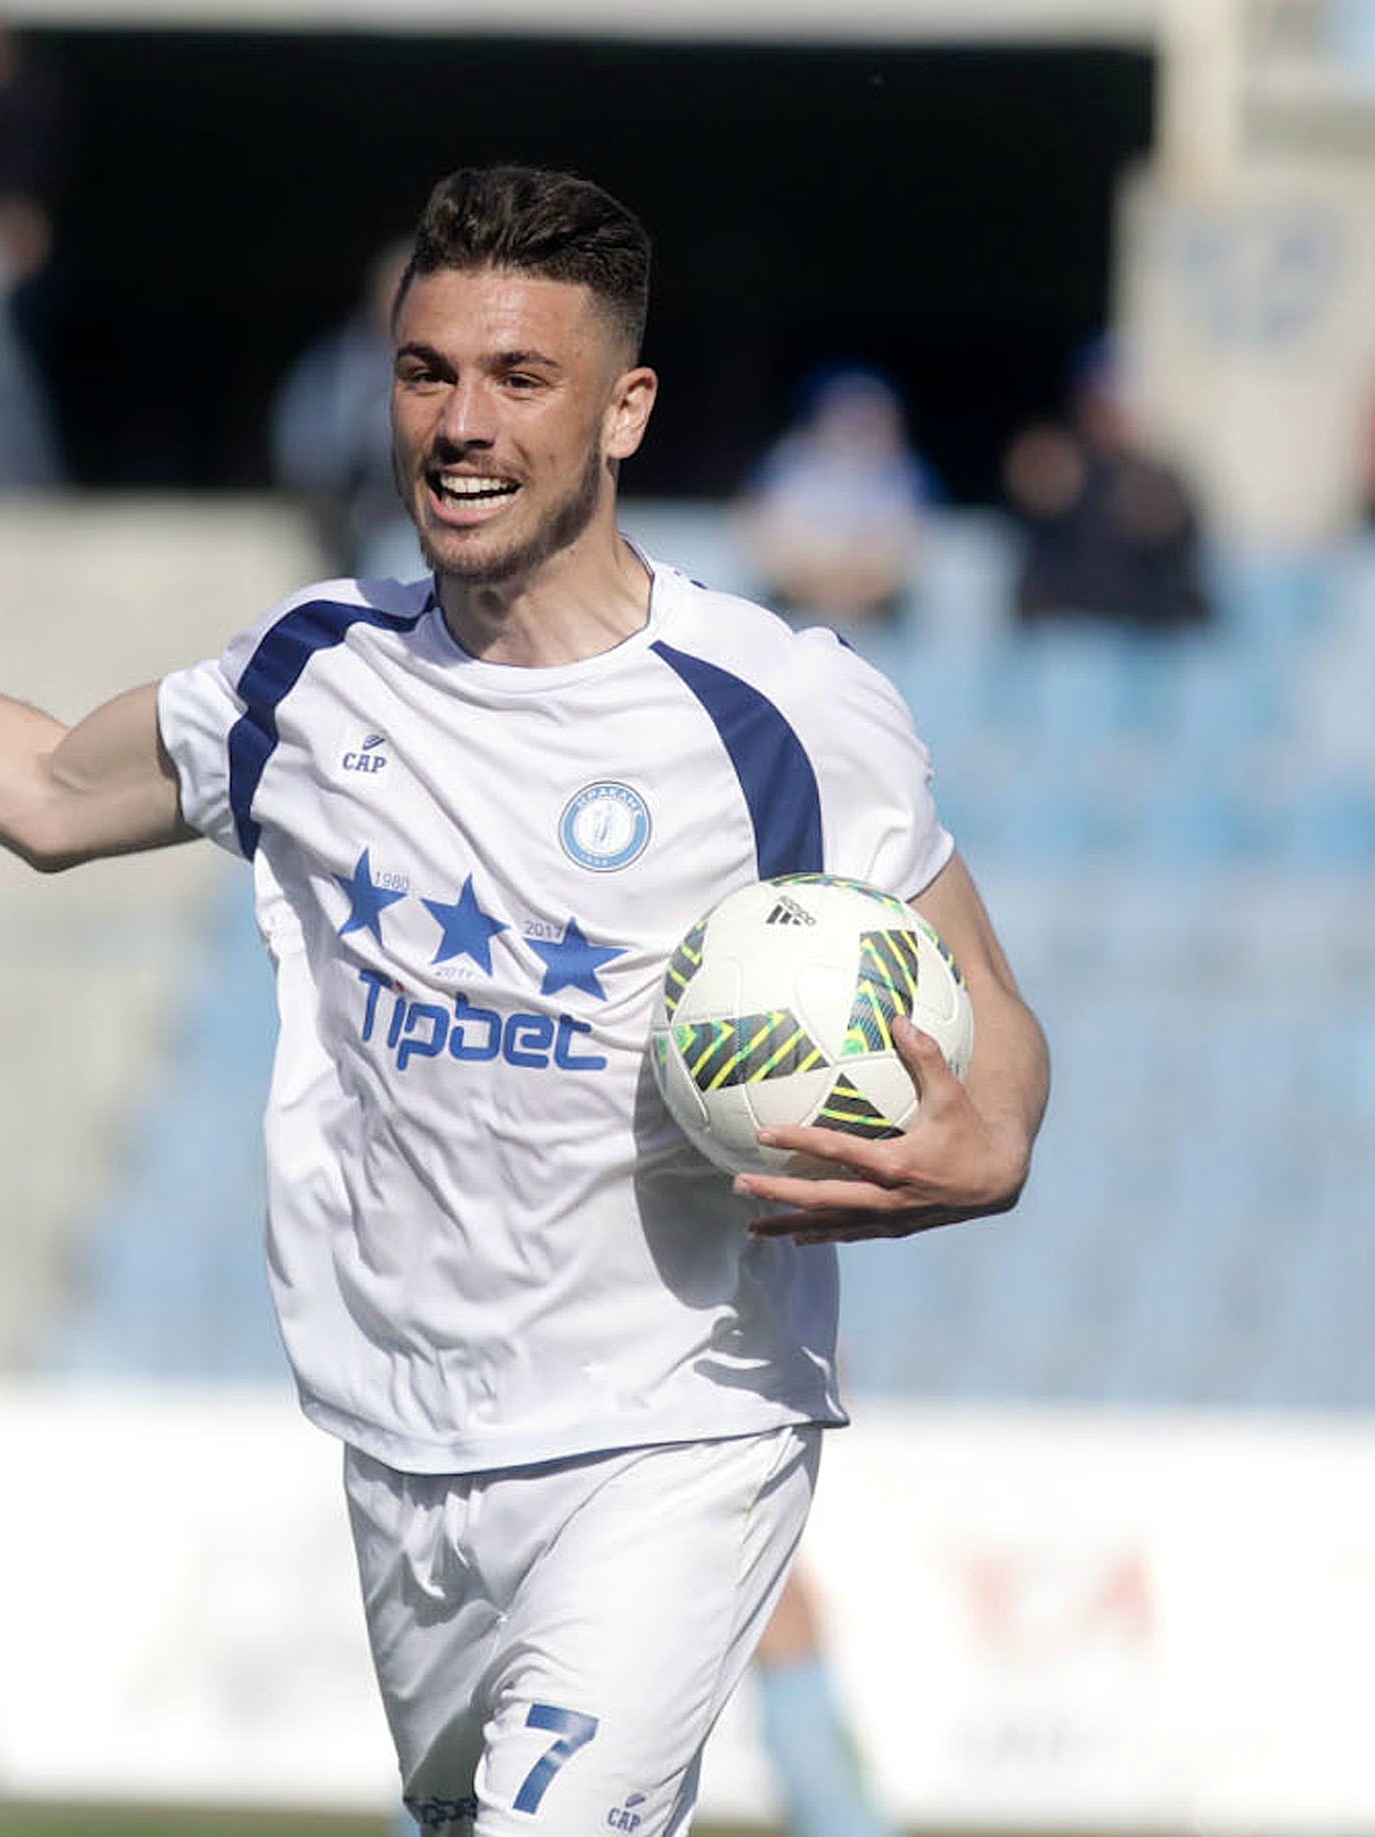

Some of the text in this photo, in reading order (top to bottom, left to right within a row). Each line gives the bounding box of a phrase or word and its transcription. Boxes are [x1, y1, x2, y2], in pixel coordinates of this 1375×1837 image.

[343, 752, 387, 772] CAP
[375, 871, 410, 890] 1980
[525, 920, 564, 938] 2017
[359, 968, 607, 1071] Tipbet
[512, 1703, 599, 1815] 7
[607, 1807, 641, 1833] CAP
